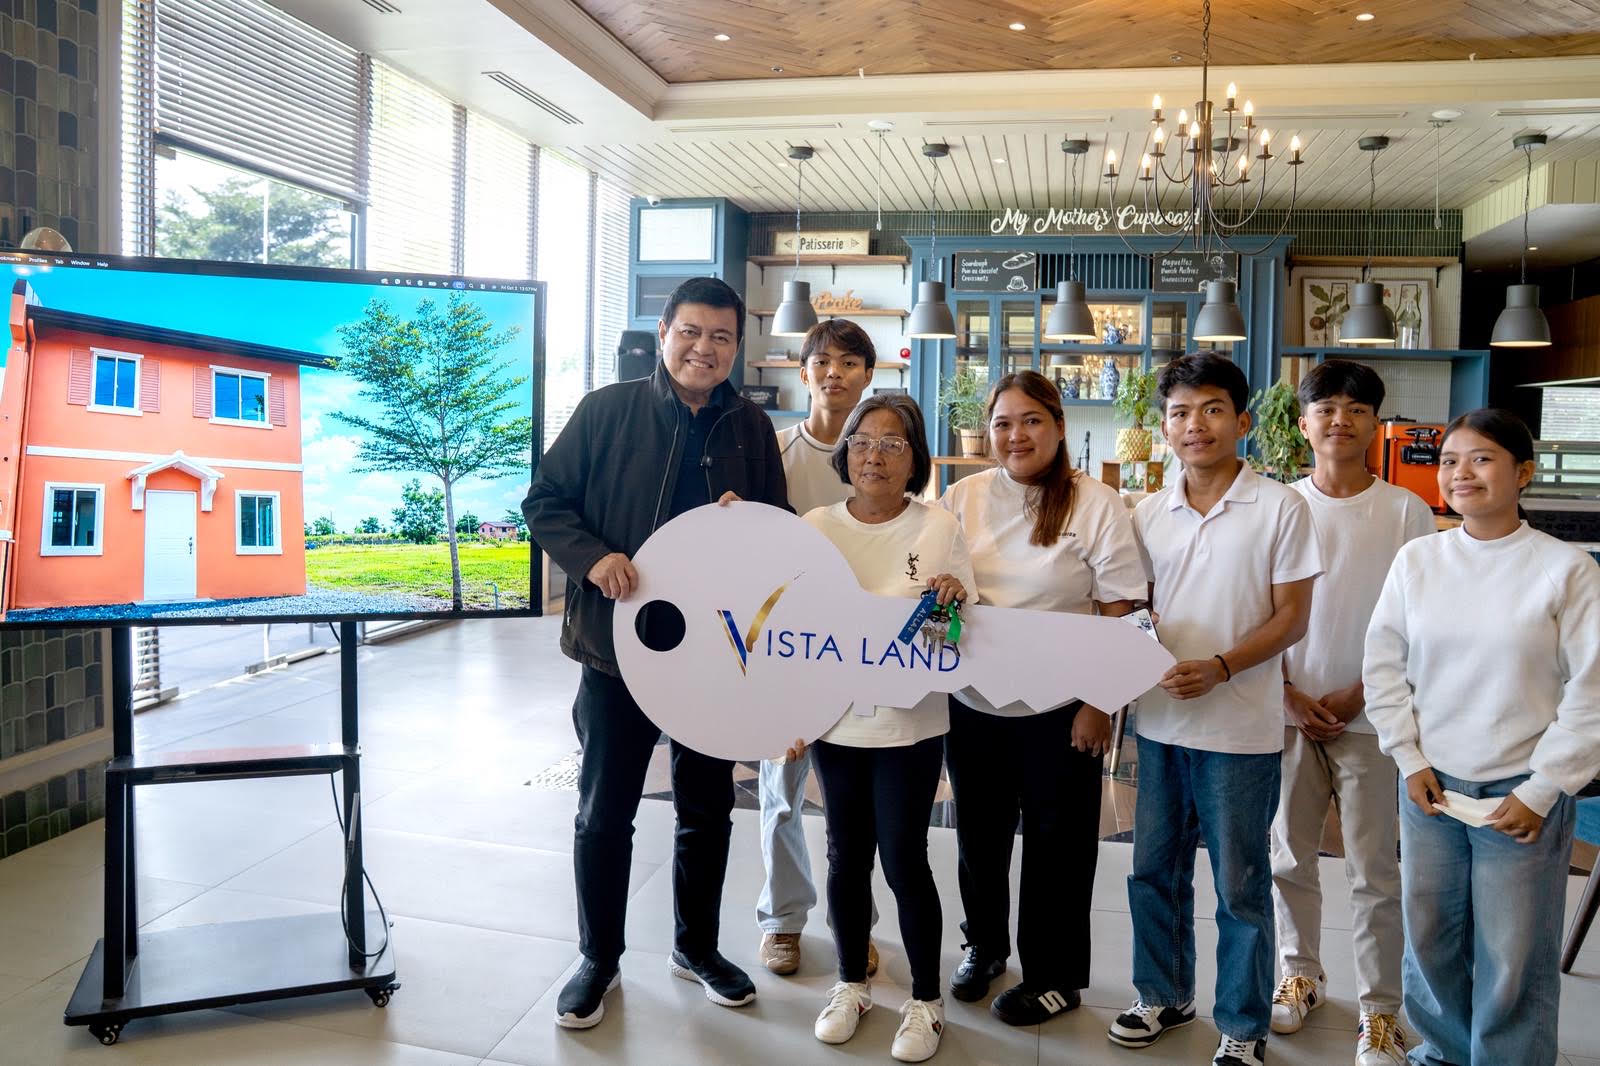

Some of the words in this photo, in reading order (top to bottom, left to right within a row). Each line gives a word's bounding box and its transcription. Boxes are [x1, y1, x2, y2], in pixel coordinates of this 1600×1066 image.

[991, 207, 1029, 236] My
[1034, 207, 1110, 232] Mother's
[800, 237, 844, 250] Patisserie
[717, 578, 843, 677] VISTA
[862, 637, 960, 672] LAND
